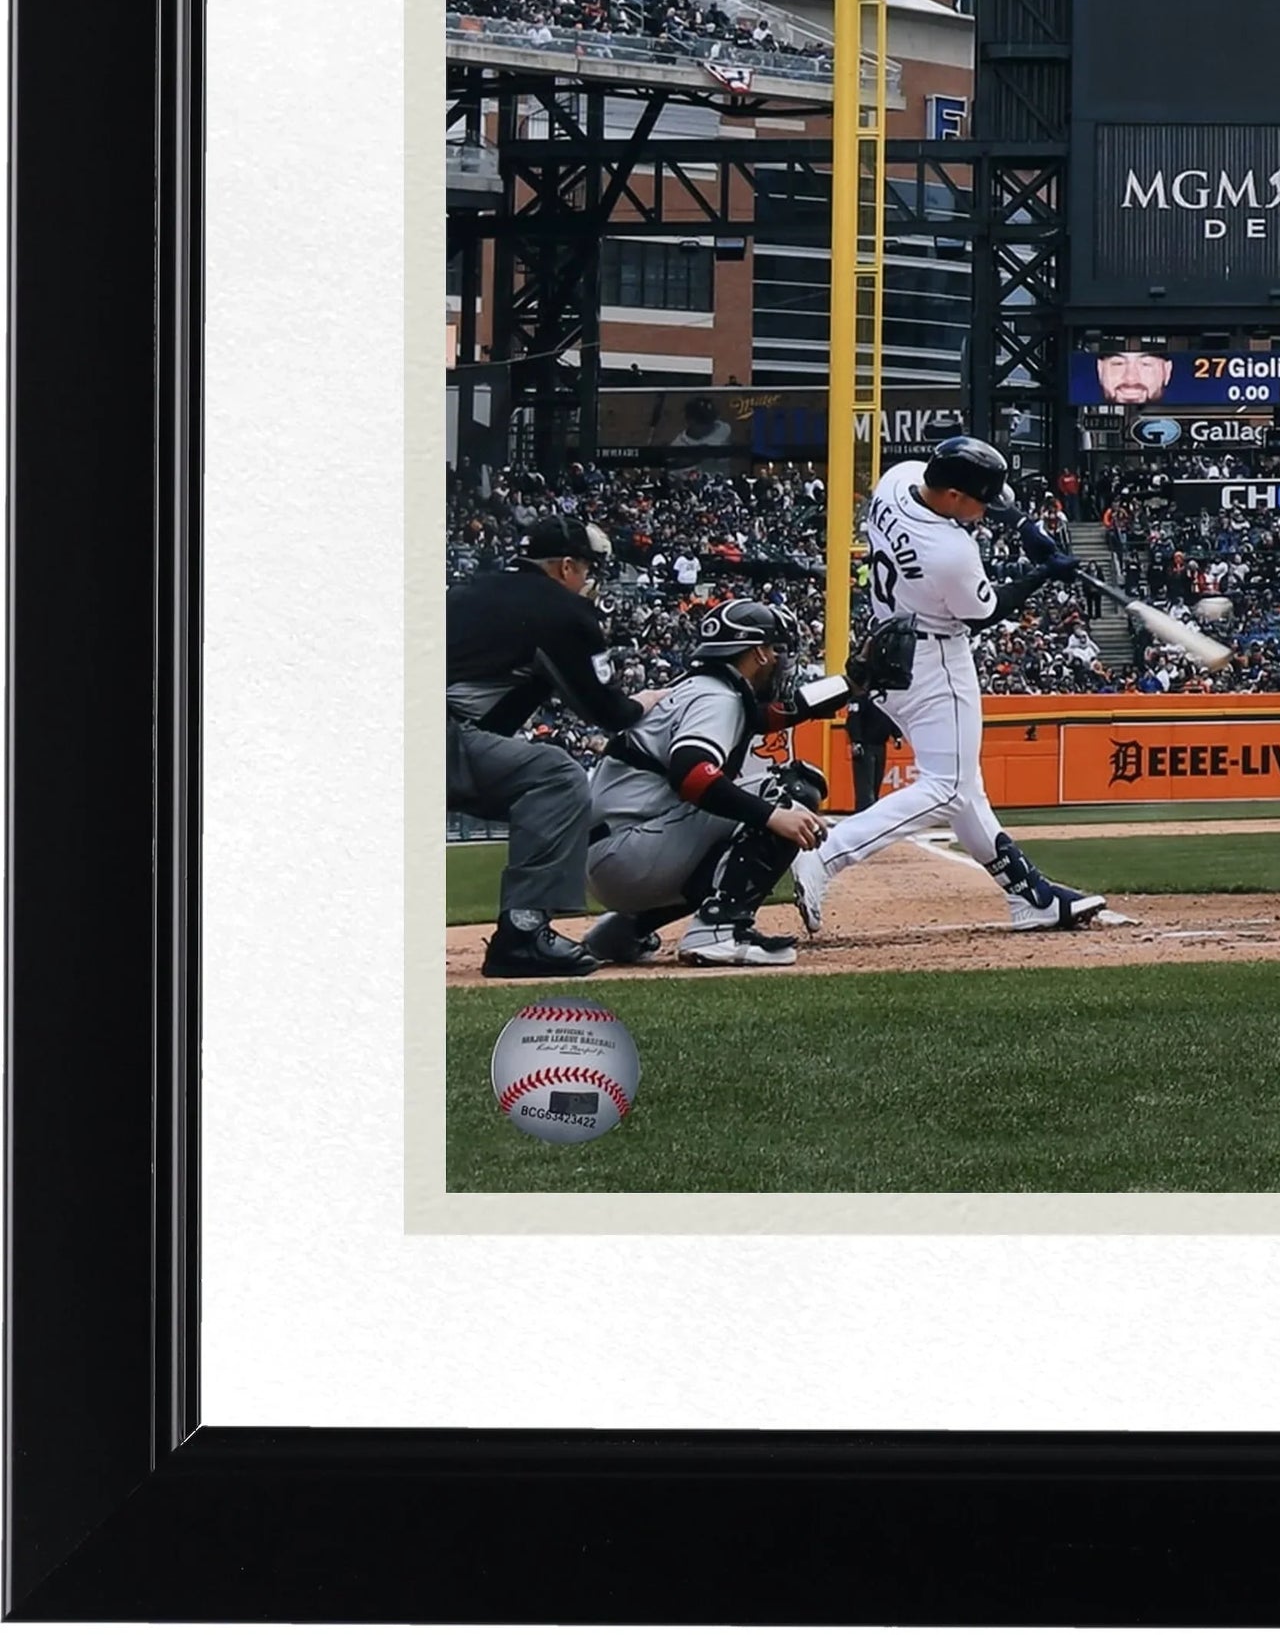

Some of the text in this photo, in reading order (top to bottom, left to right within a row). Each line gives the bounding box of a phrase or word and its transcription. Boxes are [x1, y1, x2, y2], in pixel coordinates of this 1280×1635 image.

[1122, 169, 1255, 209] MGM
[1195, 359, 1225, 378] 27
[1229, 386, 1269, 400] 0.00
